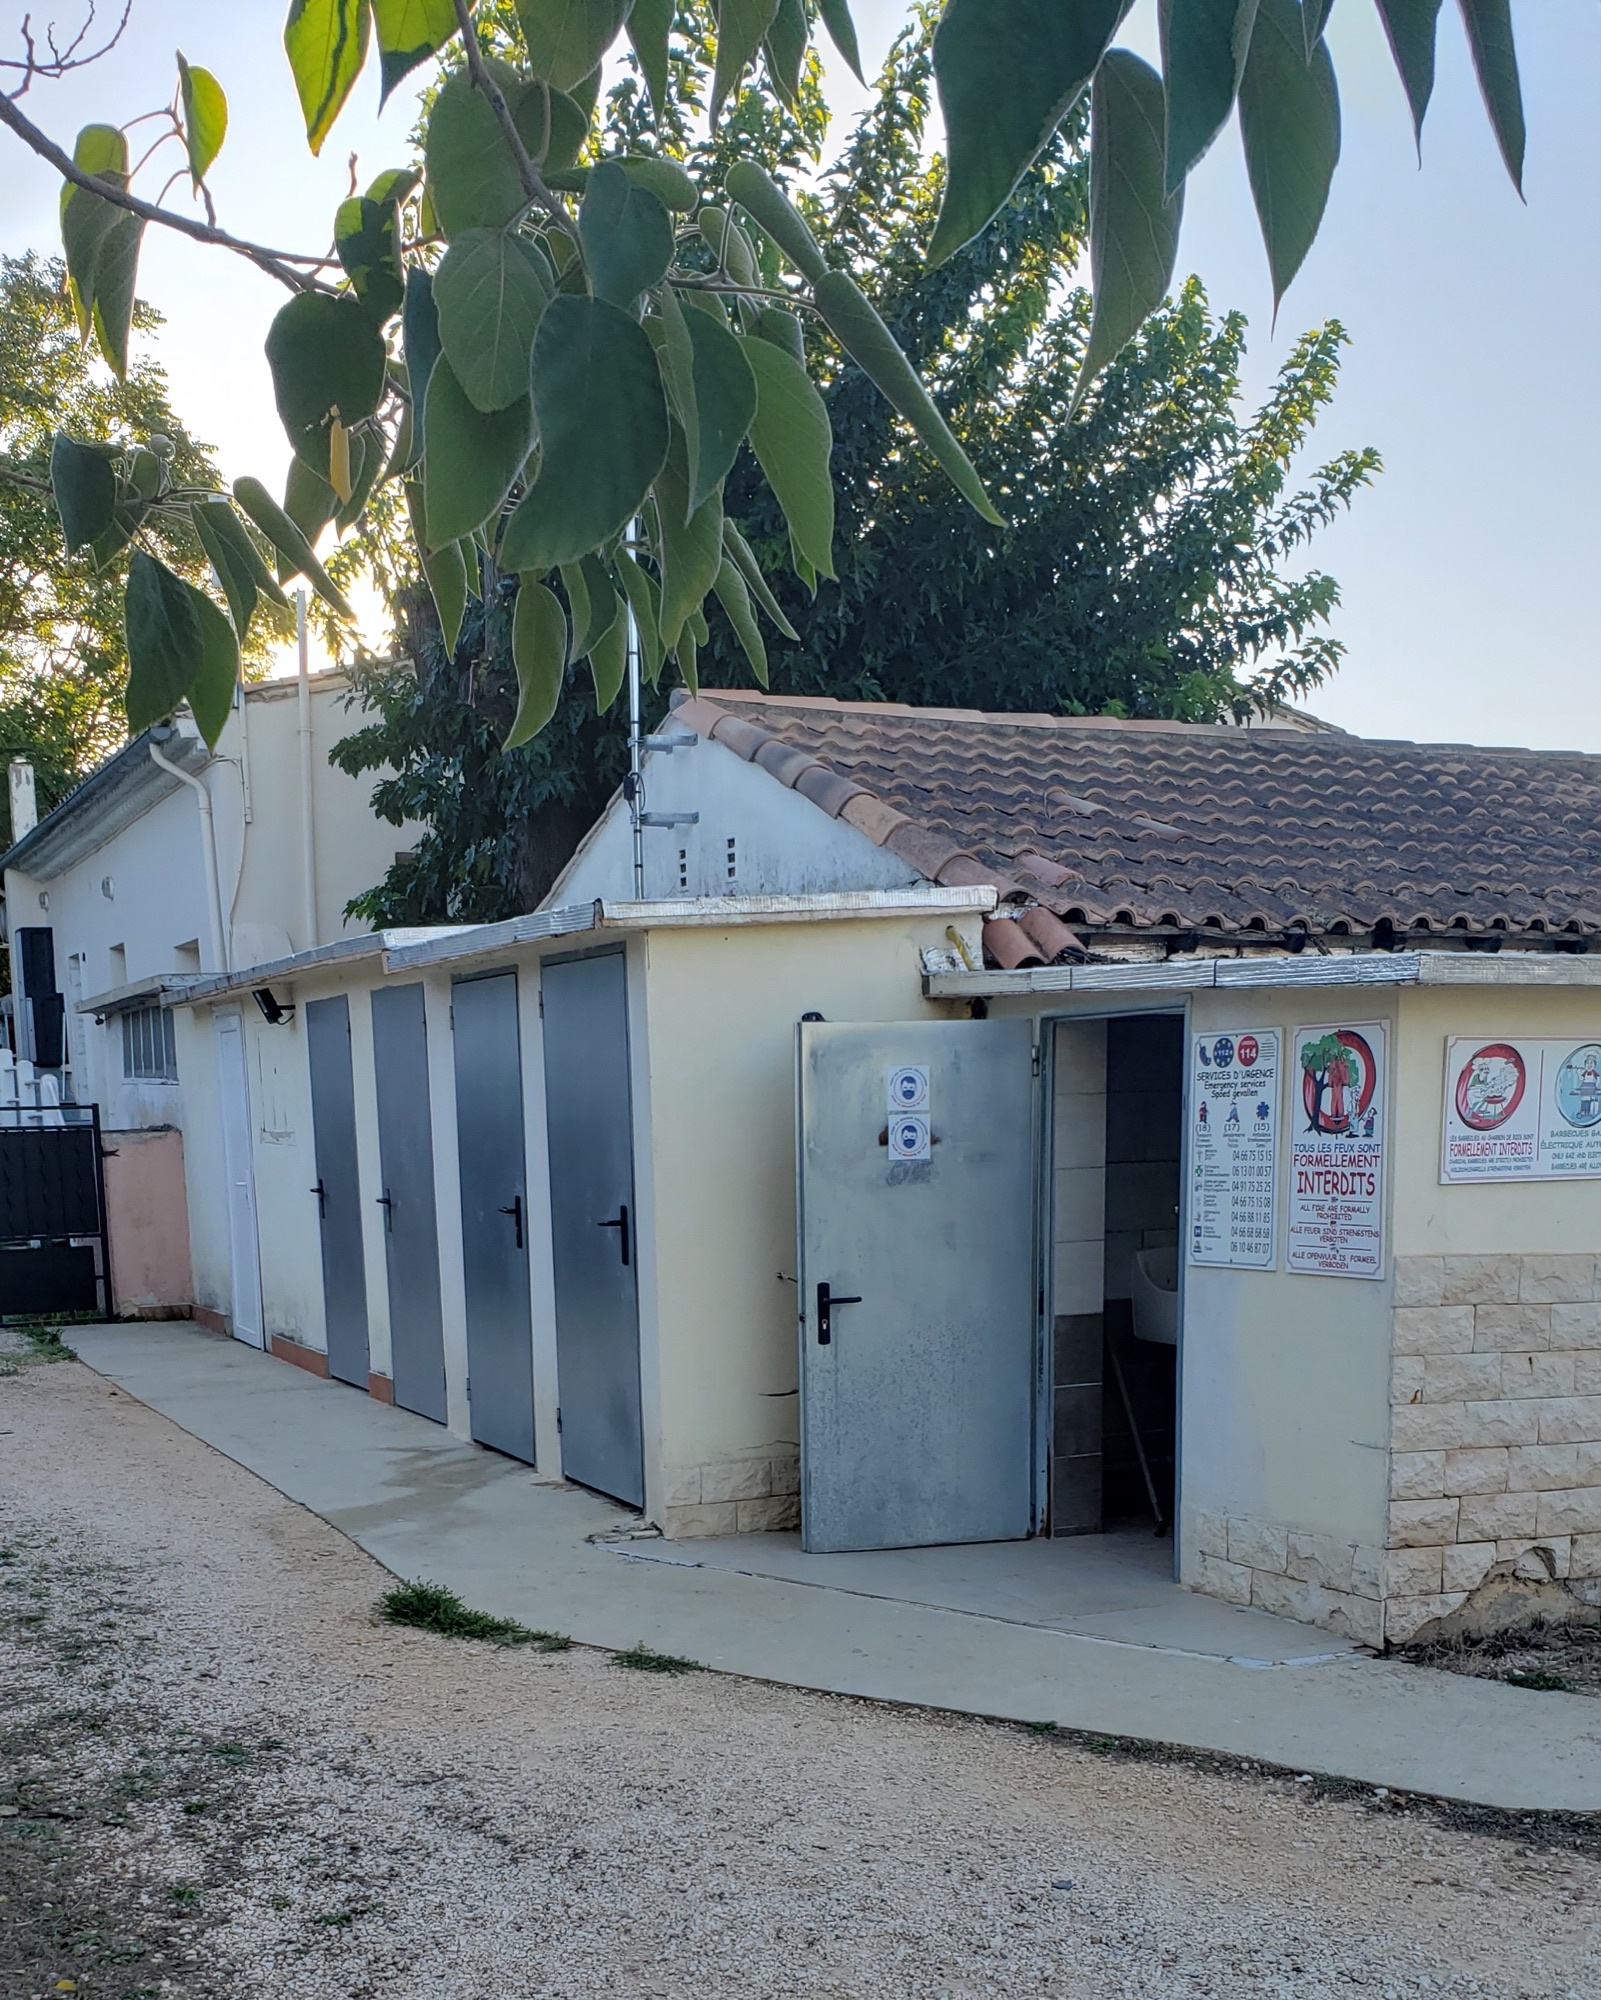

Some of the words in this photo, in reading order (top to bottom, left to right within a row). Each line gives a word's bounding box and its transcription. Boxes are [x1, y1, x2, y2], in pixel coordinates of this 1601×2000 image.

[1240, 1048, 1256, 1059] 114
[1197, 1071, 1231, 1081] SERVICES
[1234, 1068, 1274, 1080] D'URGENCE
[1204, 1081, 1237, 1091] Emergency
[1240, 1080, 1266, 1088] services
[1211, 1090, 1230, 1100] Spoed
[1233, 1090, 1258, 1099] gevallen
[1195, 1124, 1211, 1133] (18)
[1224, 1124, 1240, 1132] (17)
[1254, 1123, 1270, 1131] (15)
[1550, 1130, 1589, 1138] BARBECUES
[1591, 1129, 1601, 1137] GA
[1294, 1144, 1314, 1153] TOUS
[1318, 1143, 1331, 1153] LES
[1334, 1144, 1355, 1153] FEUX
[1358, 1144, 1381, 1153] SONT
[1450, 1142, 1497, 1157] FORMELLEMENT
[1500, 1142, 1533, 1156] INTERDITS
[1540, 1140, 1582, 1150] ÉLECTRIQUE
[1232, 1150, 1239, 1161] 04
[1241, 1150, 1247, 1161] 66
[1249, 1150, 1256, 1161] 75
[1258, 1150, 1264, 1161] 15
[1265, 1150, 1272, 1161] 15
[1294, 1154, 1380, 1168] FORMELLEMENT
[1241, 1166, 1247, 1176] 13
[1249, 1166, 1255, 1176] 01
[1256, 1166, 1263, 1177] 00
[1264, 1166, 1272, 1177] 57
[1232, 1181, 1239, 1192] 04
[1240, 1181, 1246, 1192] 91
[1248, 1181, 1255, 1192] 75
[1256, 1181, 1263, 1192] 25
[1264, 1181, 1271, 1192] 25
[1297, 1170, 1375, 1196] INTERDITS
[1232, 1196, 1239, 1207] 04
[1239, 1196, 1247, 1207] 66
[1248, 1197, 1255, 1207] 75
[1256, 1197, 1262, 1207] 15
[1263, 1197, 1270, 1208] 08
[1340, 1205, 1370, 1214] FORMALLY
[1231, 1212, 1238, 1222] 04
[1239, 1212, 1246, 1222] 66
[1256, 1212, 1262, 1223] 11
[1263, 1212, 1270, 1223] 85
[1317, 1212, 1352, 1221] PROHIBITED
[1231, 1227, 1238, 1238] 04
[1239, 1227, 1246, 1238] 66
[1290, 1226, 1302, 1234] ALLE
[1304, 1227, 1320, 1235] FEUER
[1338, 1228, 1380, 1238] STRENGSTENS
[1239, 1242, 1245, 1253] 10
[1262, 1243, 1270, 1254] 07
[1307, 1252, 1337, 1260] OPENVUUR
[1350, 1255, 1377, 1264] FORMEEL
[1318, 1261, 1348, 1269] VERBODEN
